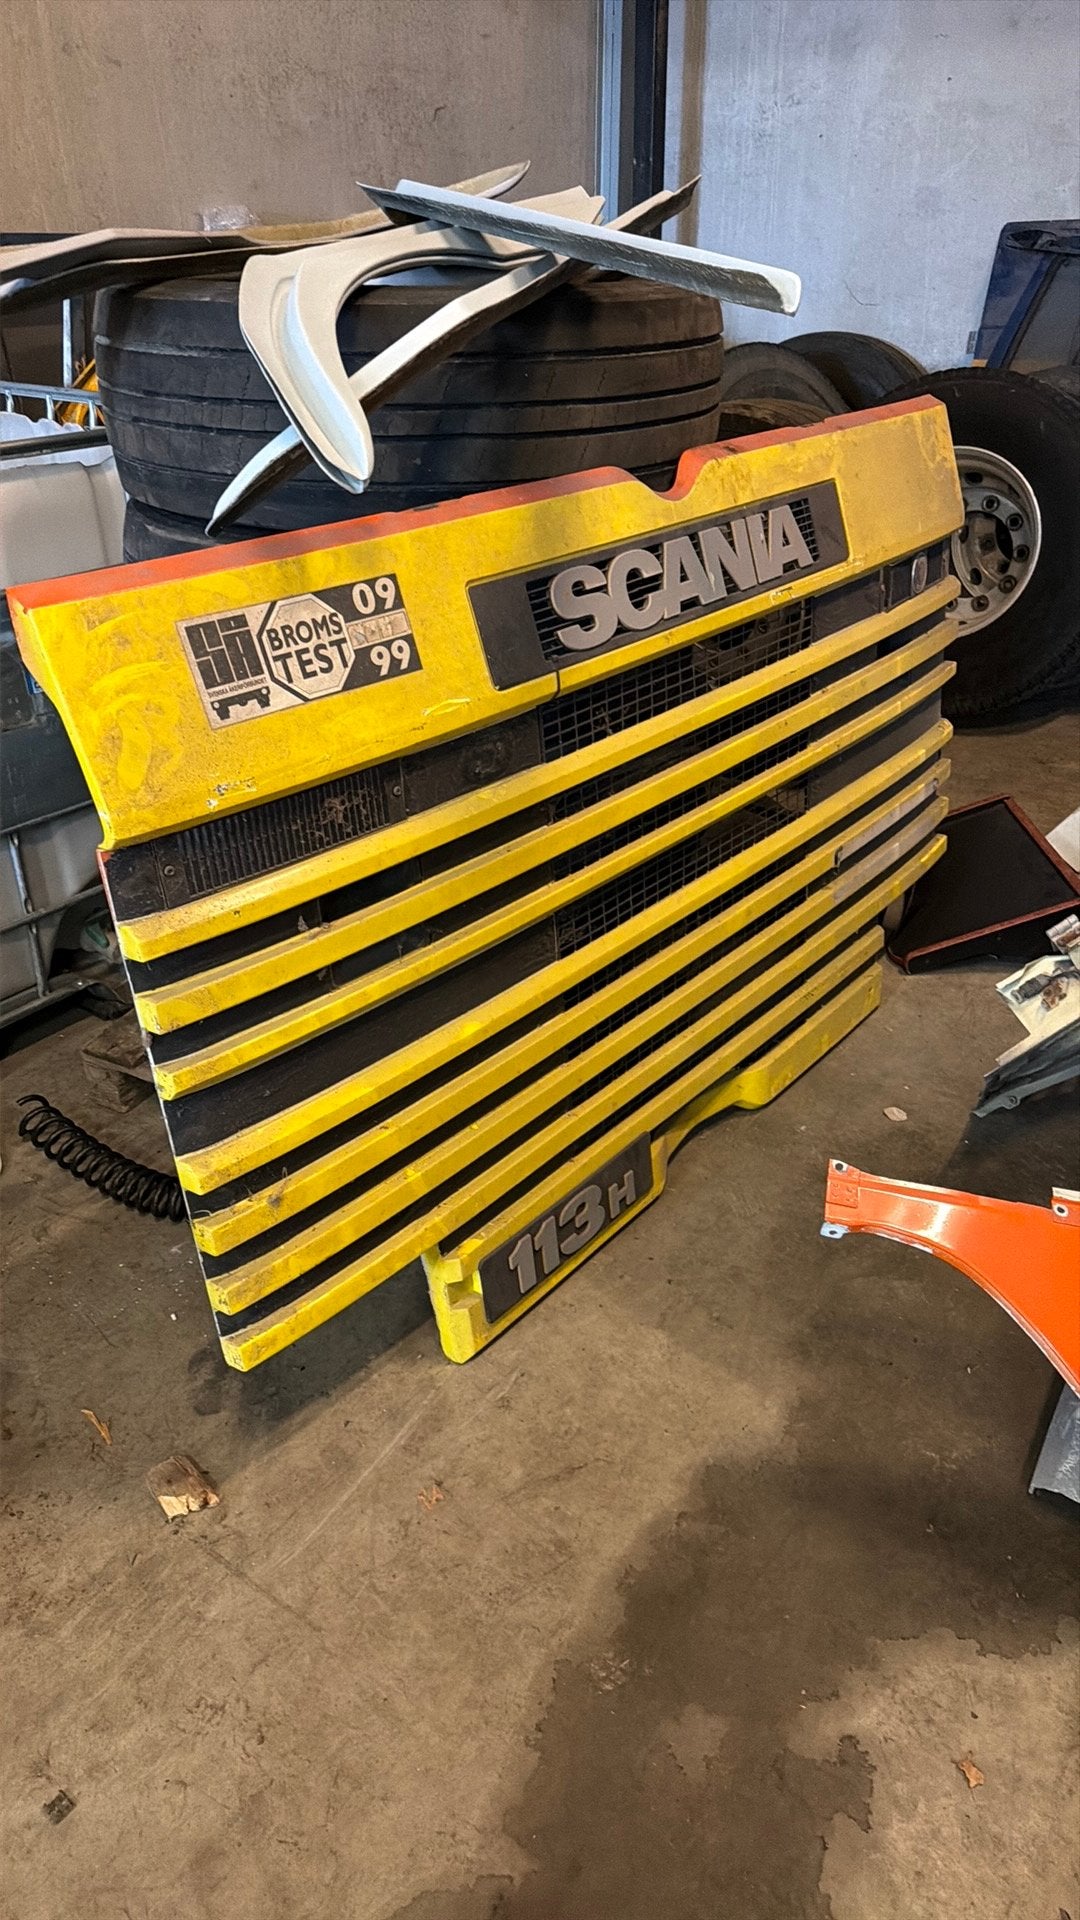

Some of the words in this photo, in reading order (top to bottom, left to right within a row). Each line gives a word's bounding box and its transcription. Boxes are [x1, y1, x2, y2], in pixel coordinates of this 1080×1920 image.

[351, 577, 396, 615] 09
[550, 504, 814, 651] SCANIA
[266, 613, 343, 651] BROMS
[273, 638, 349, 684] TEST
[370, 639, 411, 677] 99
